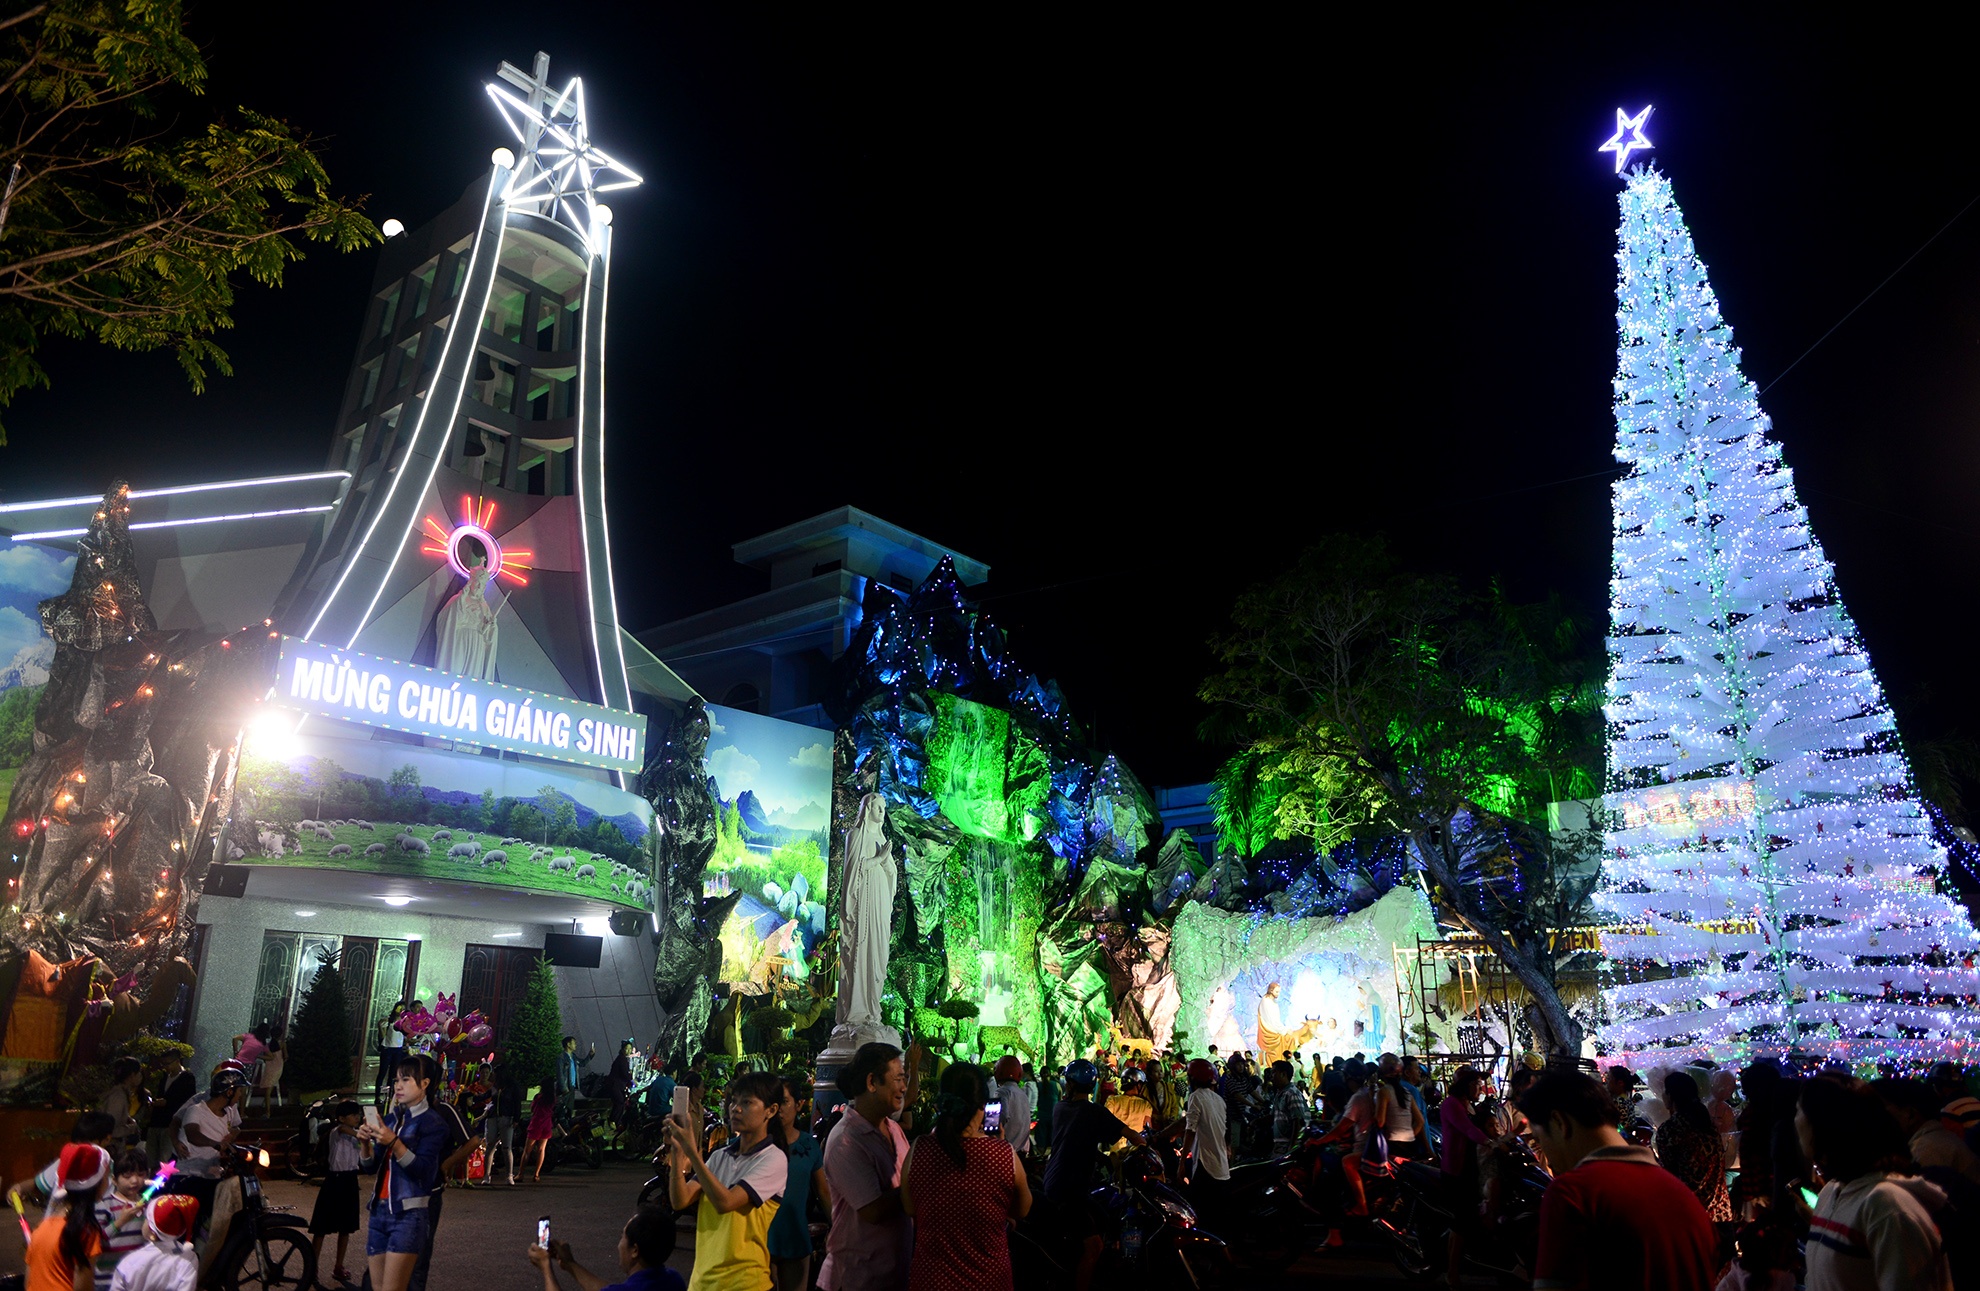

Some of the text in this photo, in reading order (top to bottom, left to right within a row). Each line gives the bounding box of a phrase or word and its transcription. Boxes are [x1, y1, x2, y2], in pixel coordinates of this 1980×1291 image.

[290, 653, 637, 761] MỪNG CHÚA GIÁNG SINH
